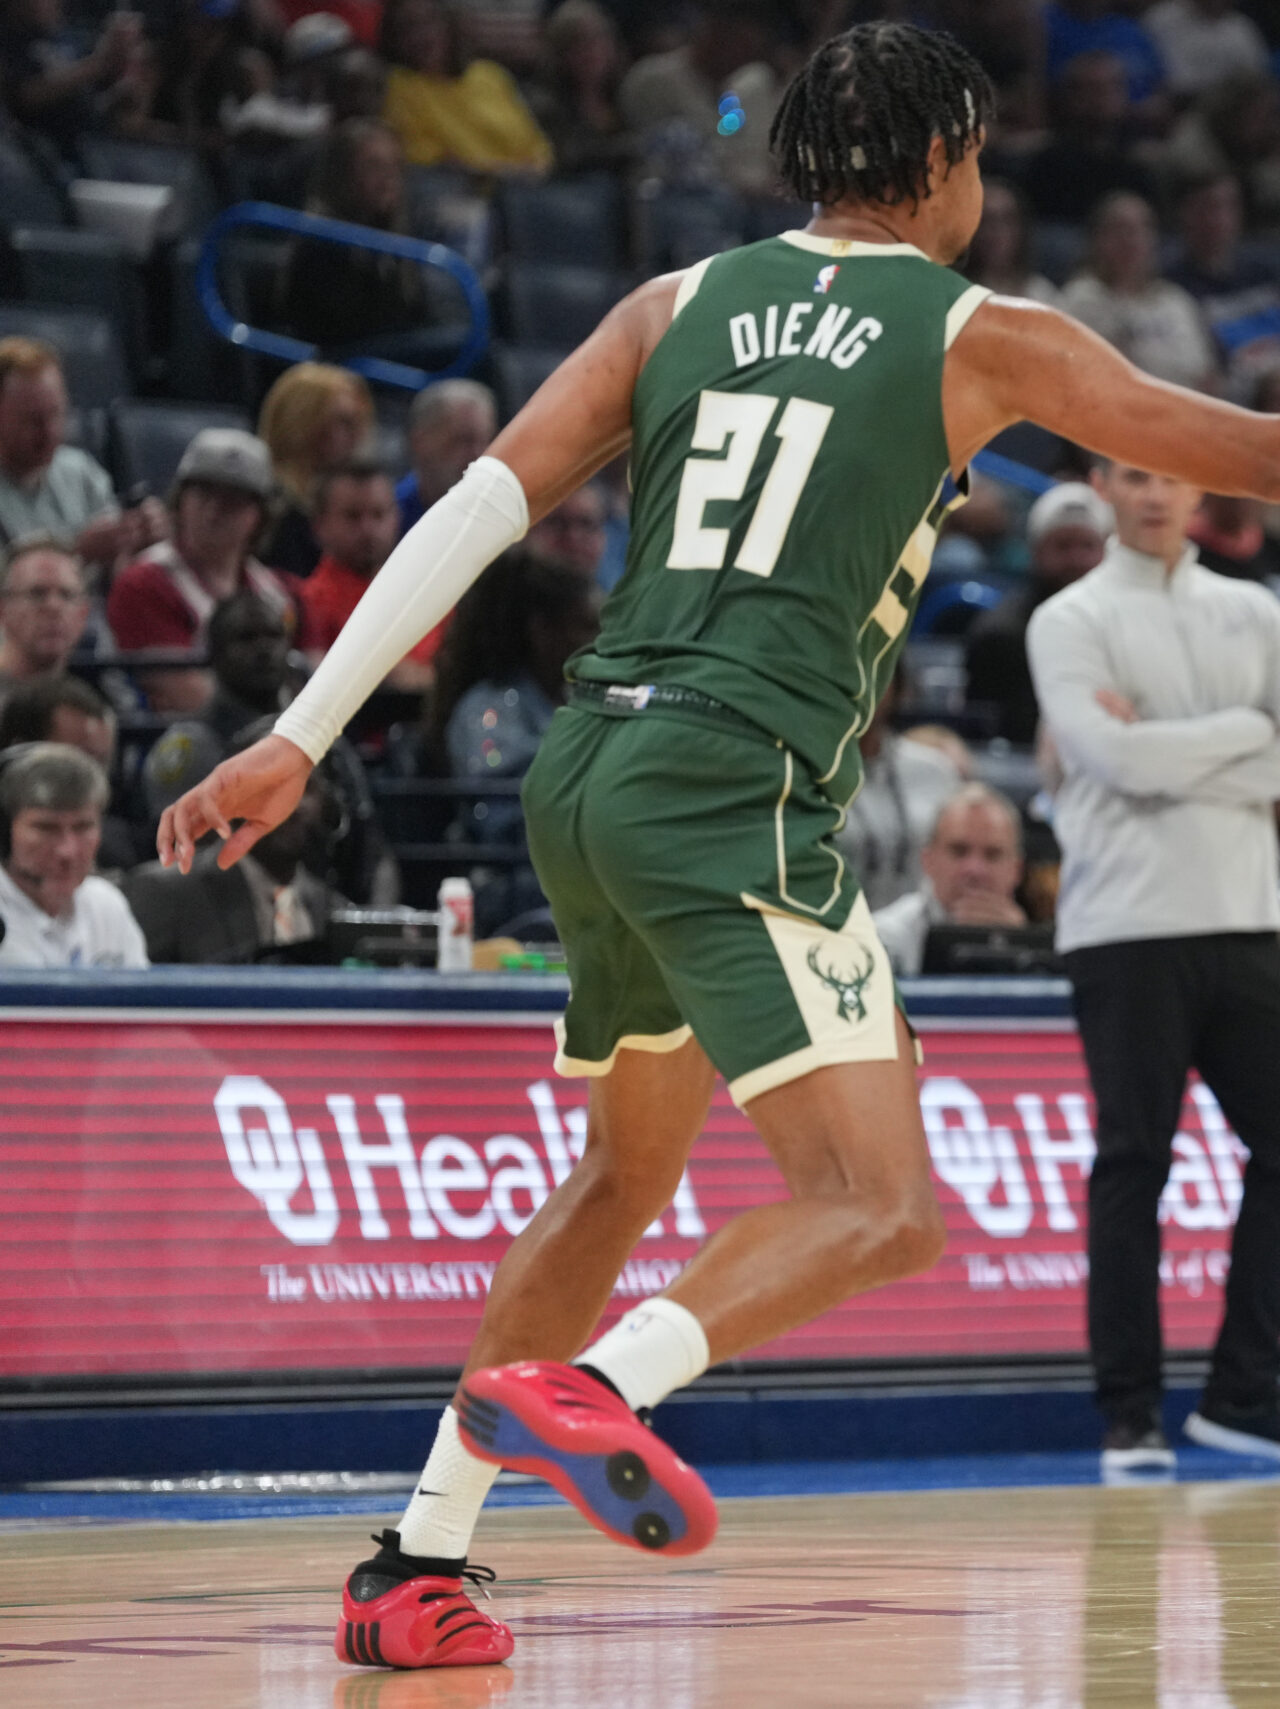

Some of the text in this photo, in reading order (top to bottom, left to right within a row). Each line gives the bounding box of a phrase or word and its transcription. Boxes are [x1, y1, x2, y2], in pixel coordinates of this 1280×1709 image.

[729, 302, 883, 369] DIENG
[666, 390, 834, 578] 21
[213, 1075, 706, 1245] OU Heal
